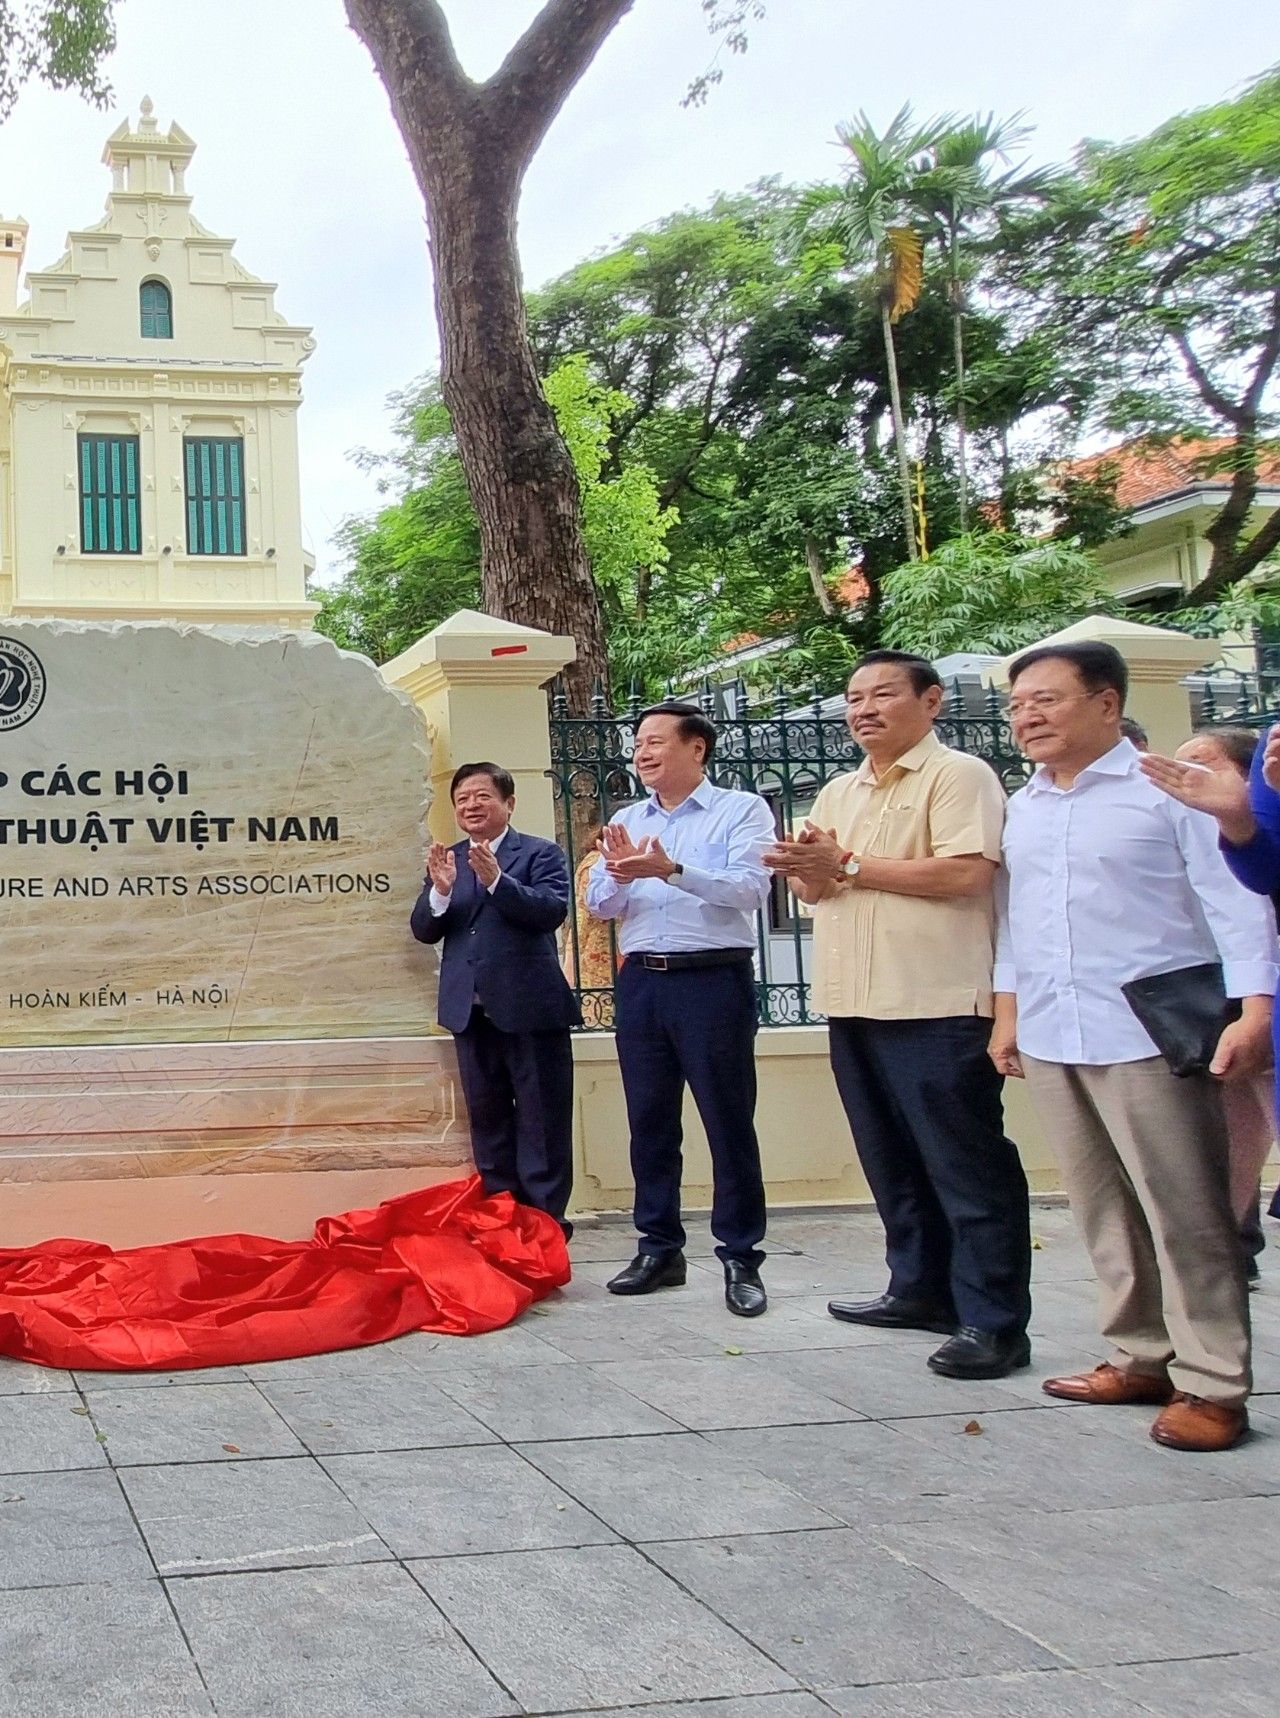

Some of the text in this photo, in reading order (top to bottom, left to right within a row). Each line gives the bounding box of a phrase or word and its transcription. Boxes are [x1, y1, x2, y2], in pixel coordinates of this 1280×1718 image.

[13, 646, 29, 660] HỌC
[27, 660, 41, 681] NGHỆ
[28, 685, 41, 710] THUẬT
[2, 714, 21, 725] NAM
[21, 764, 101, 796] CÁC
[115, 763, 188, 803] HỘI
[146, 810, 235, 851] VIỆT
[248, 817, 339, 842] NAM
[54, 878, 108, 897] AND
[119, 876, 188, 896] ARTS
[197, 873, 390, 895] ASSOCIATIONS
[9, 989, 70, 1008] HOÀN
[79, 984, 126, 1007] KIẾM
[157, 985, 184, 1005] HÀ
[192, 984, 228, 1008] NỘI
